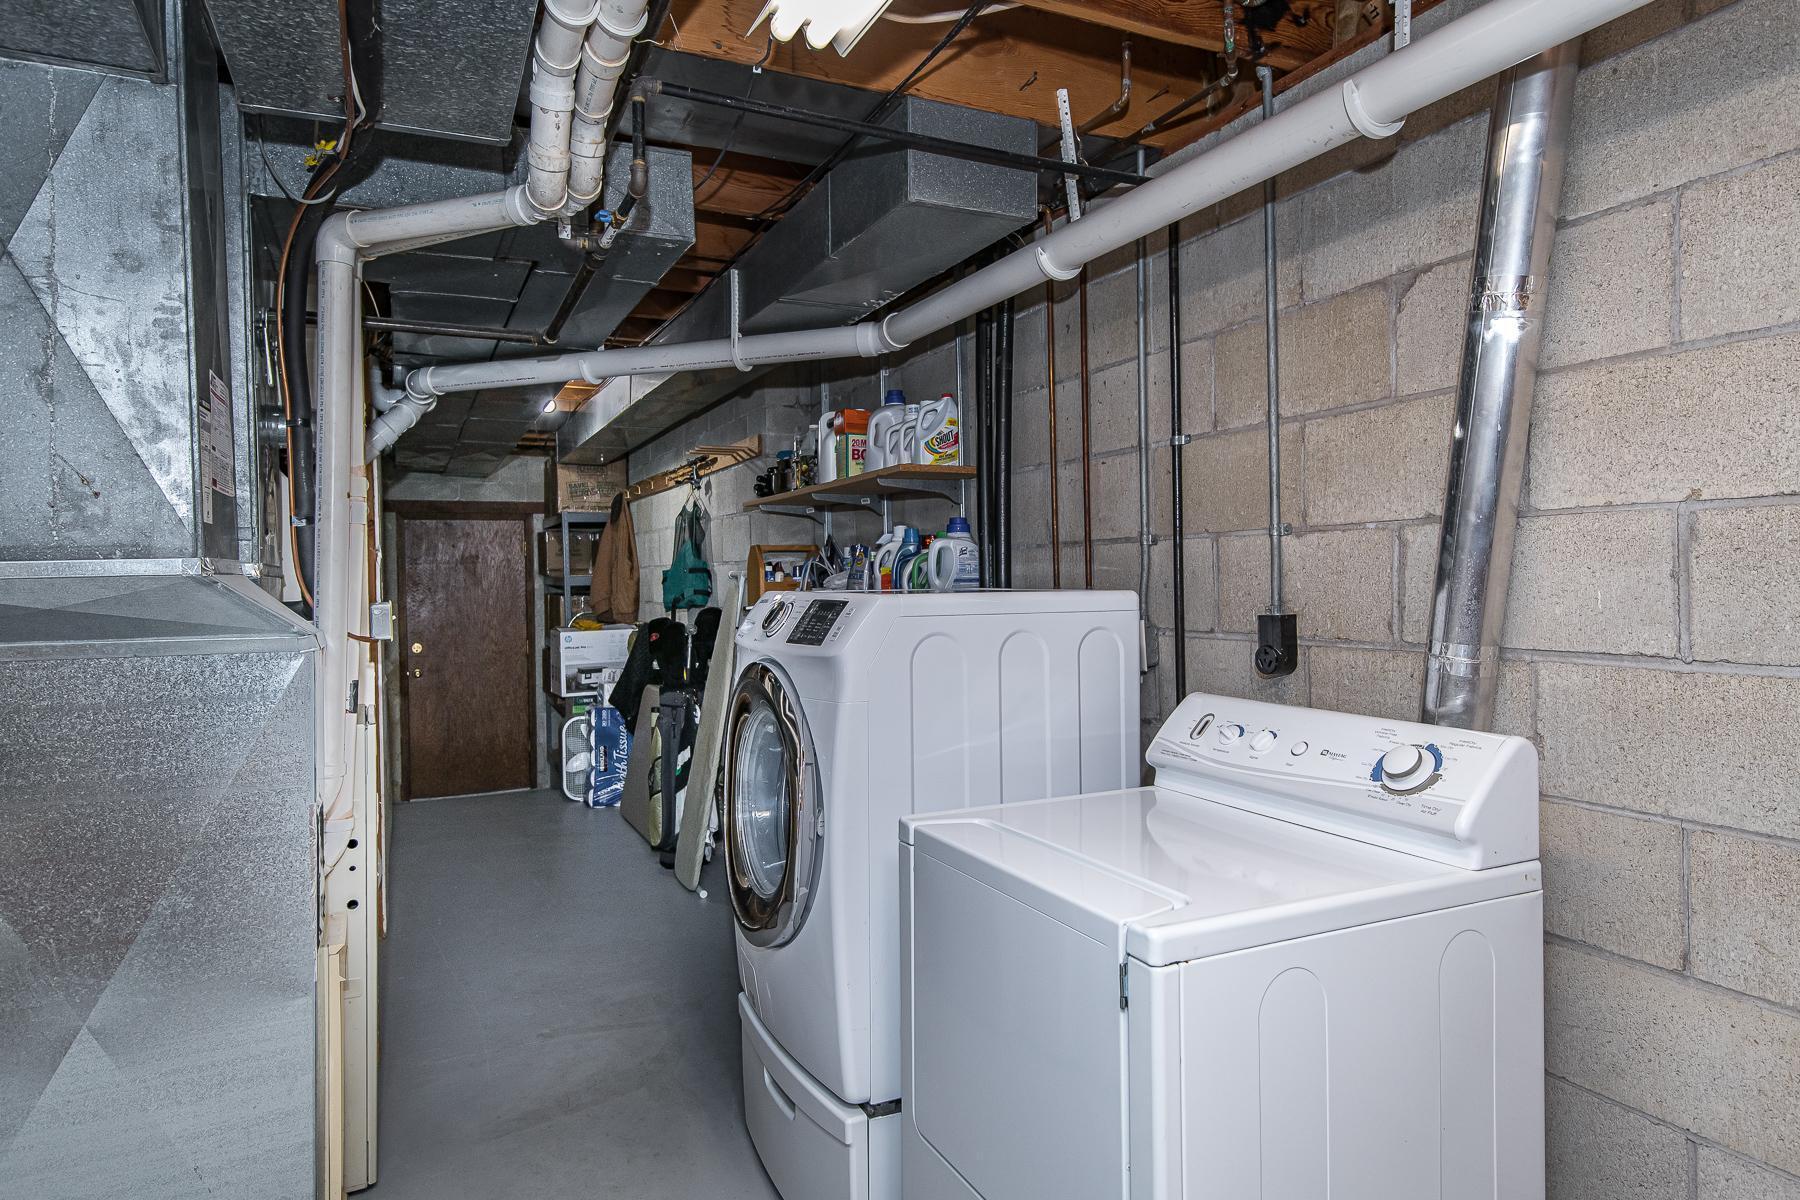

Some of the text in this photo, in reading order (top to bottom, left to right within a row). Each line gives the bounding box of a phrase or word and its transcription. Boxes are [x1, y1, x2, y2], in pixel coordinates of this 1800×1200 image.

[851, 438, 860, 447] 20
[935, 430, 954, 447] SHOUT
[613, 725, 628, 760] Tissue
